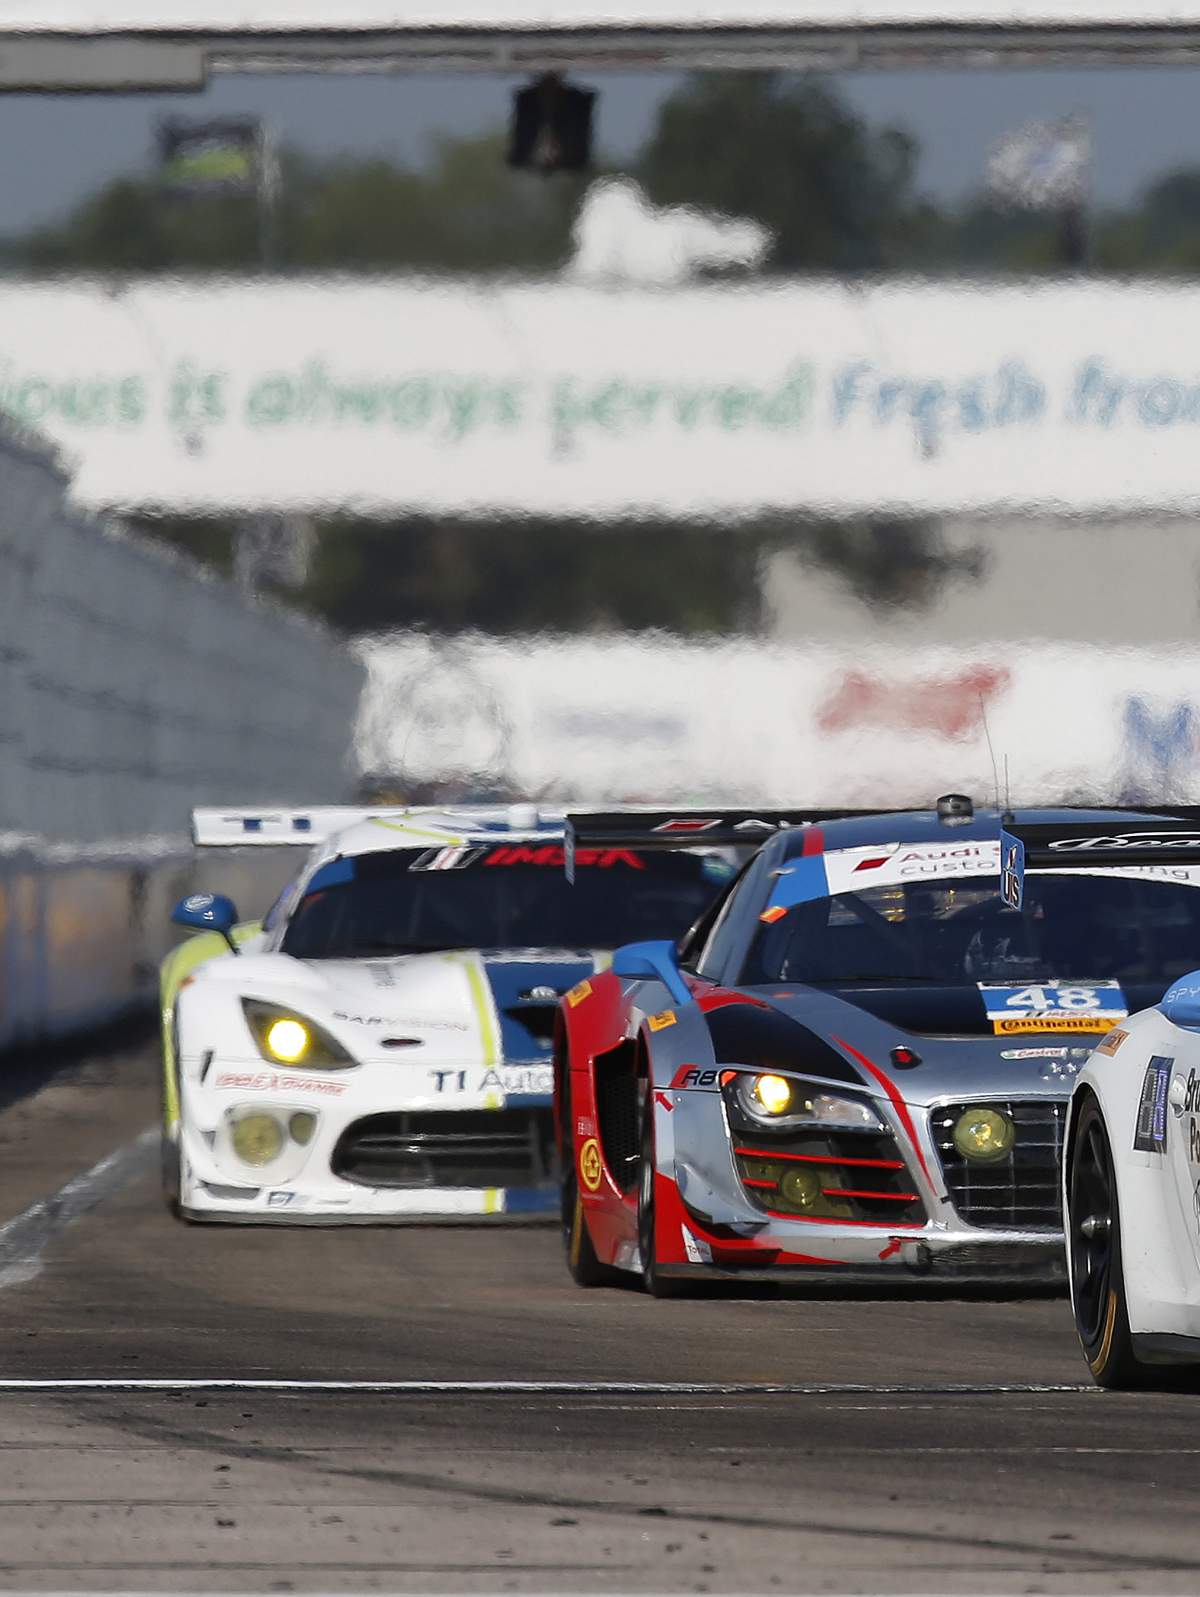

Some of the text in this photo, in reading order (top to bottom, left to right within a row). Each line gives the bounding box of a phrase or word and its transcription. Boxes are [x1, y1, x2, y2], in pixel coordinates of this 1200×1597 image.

[1006, 986, 1100, 1010] 48
[430, 1070, 467, 1091] TI
[680, 1069, 717, 1086] R8
